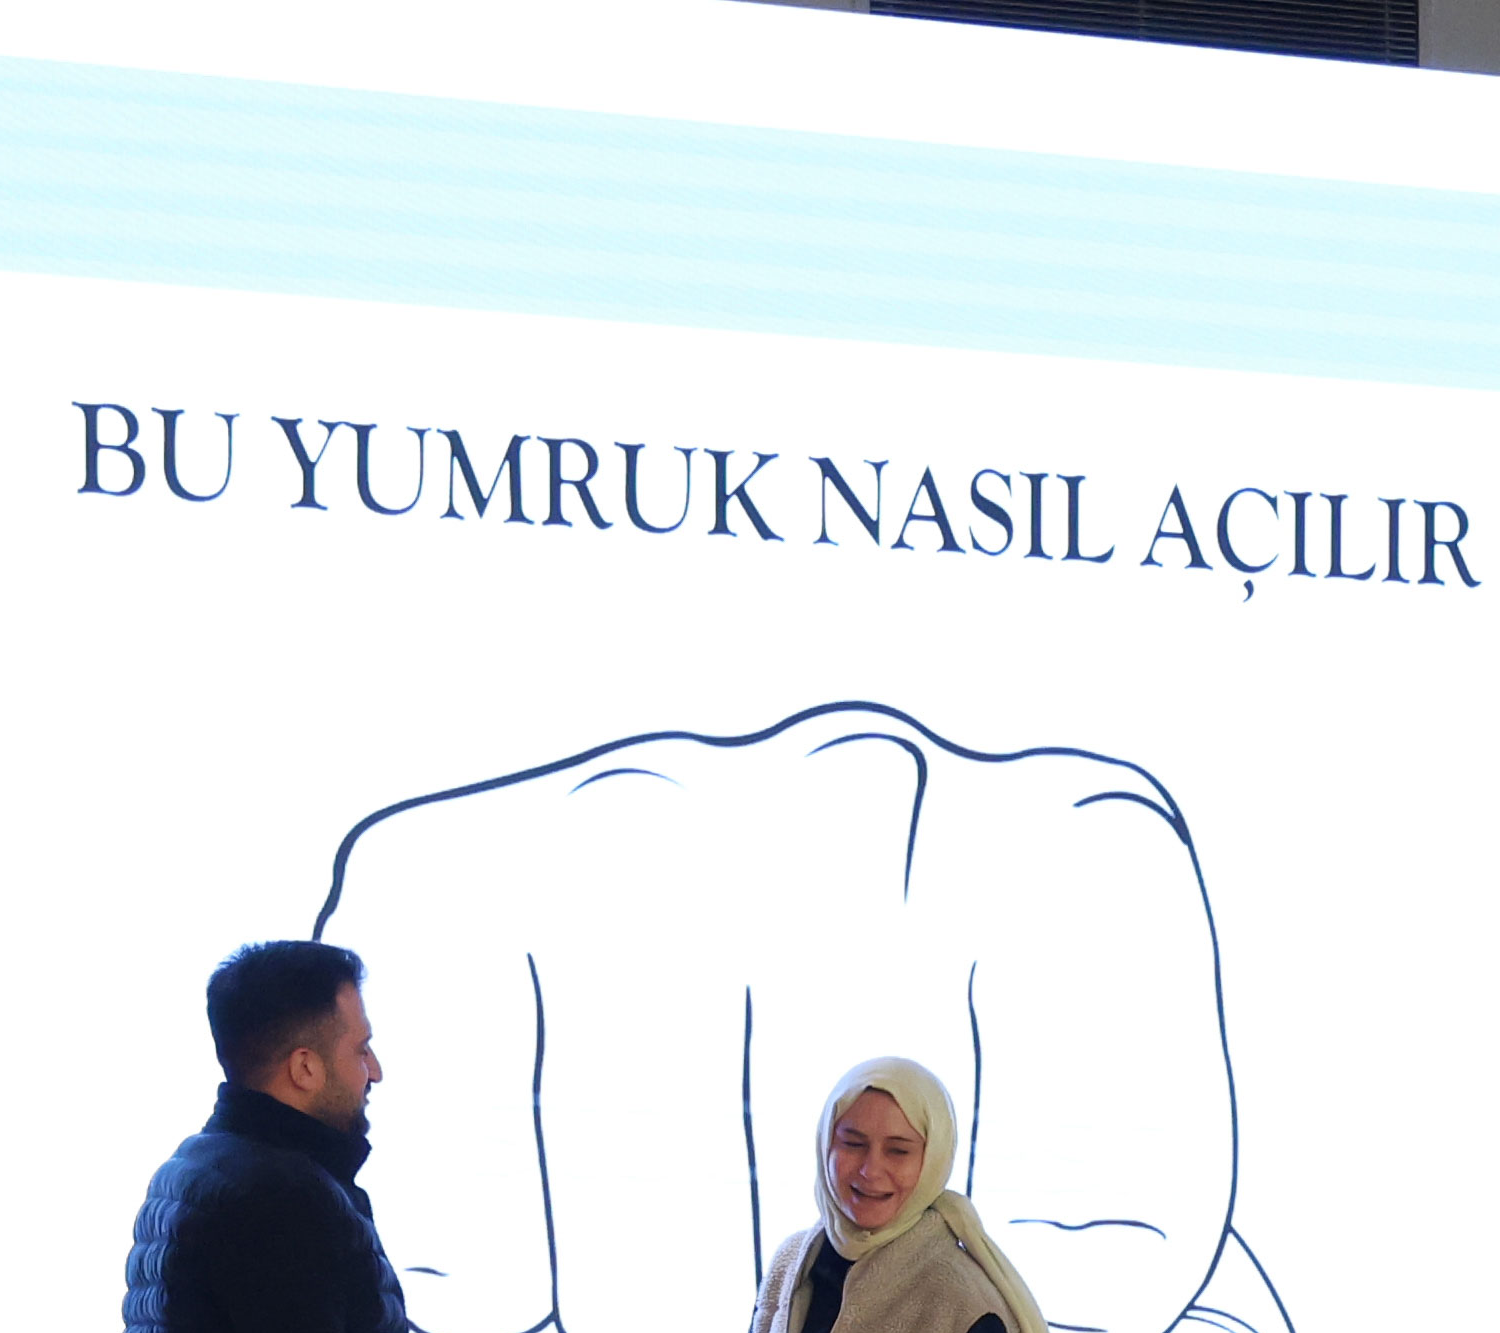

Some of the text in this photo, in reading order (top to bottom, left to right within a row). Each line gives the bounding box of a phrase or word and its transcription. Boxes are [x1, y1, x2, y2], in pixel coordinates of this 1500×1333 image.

[71, 401, 240, 502] BU
[270, 416, 785, 542] YUMRUK
[808, 456, 1115, 564] NASIL
[1139, 484, 1482, 602] AÇILIR
